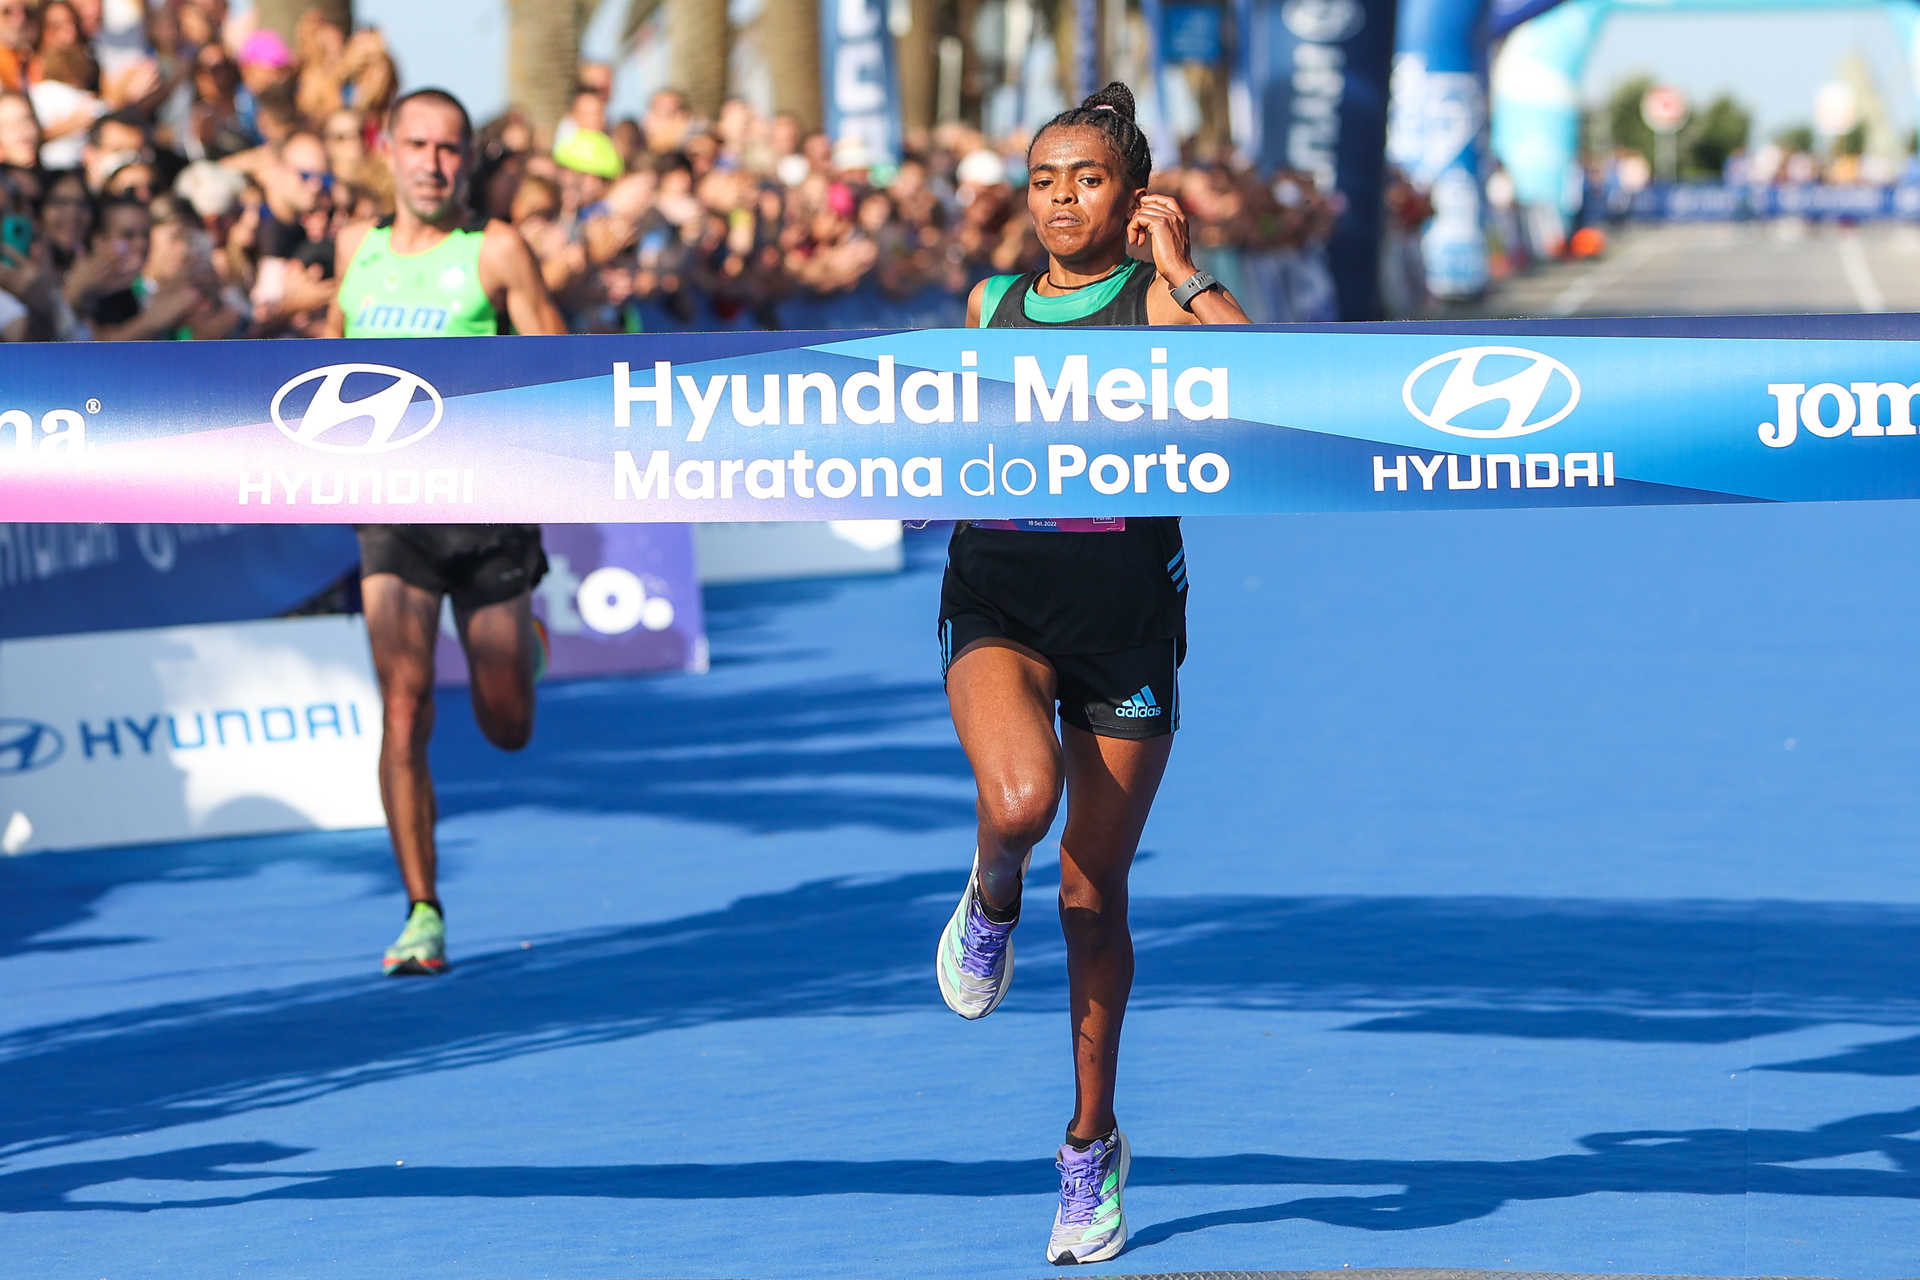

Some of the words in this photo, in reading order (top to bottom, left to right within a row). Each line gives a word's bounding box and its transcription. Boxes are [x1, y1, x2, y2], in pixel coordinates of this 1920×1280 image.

[612, 350, 979, 442] Hyundai
[1014, 346, 1230, 422] Meia
[238, 467, 475, 505] HYUNDAI
[614, 449, 944, 501] Maratona
[960, 442, 1038, 497] do
[1048, 444, 1230, 495] Porto
[1372, 451, 1616, 492] HYUNDAI
[78, 701, 363, 759] HYUNDAI
[1115, 704, 1162, 718] adidas
